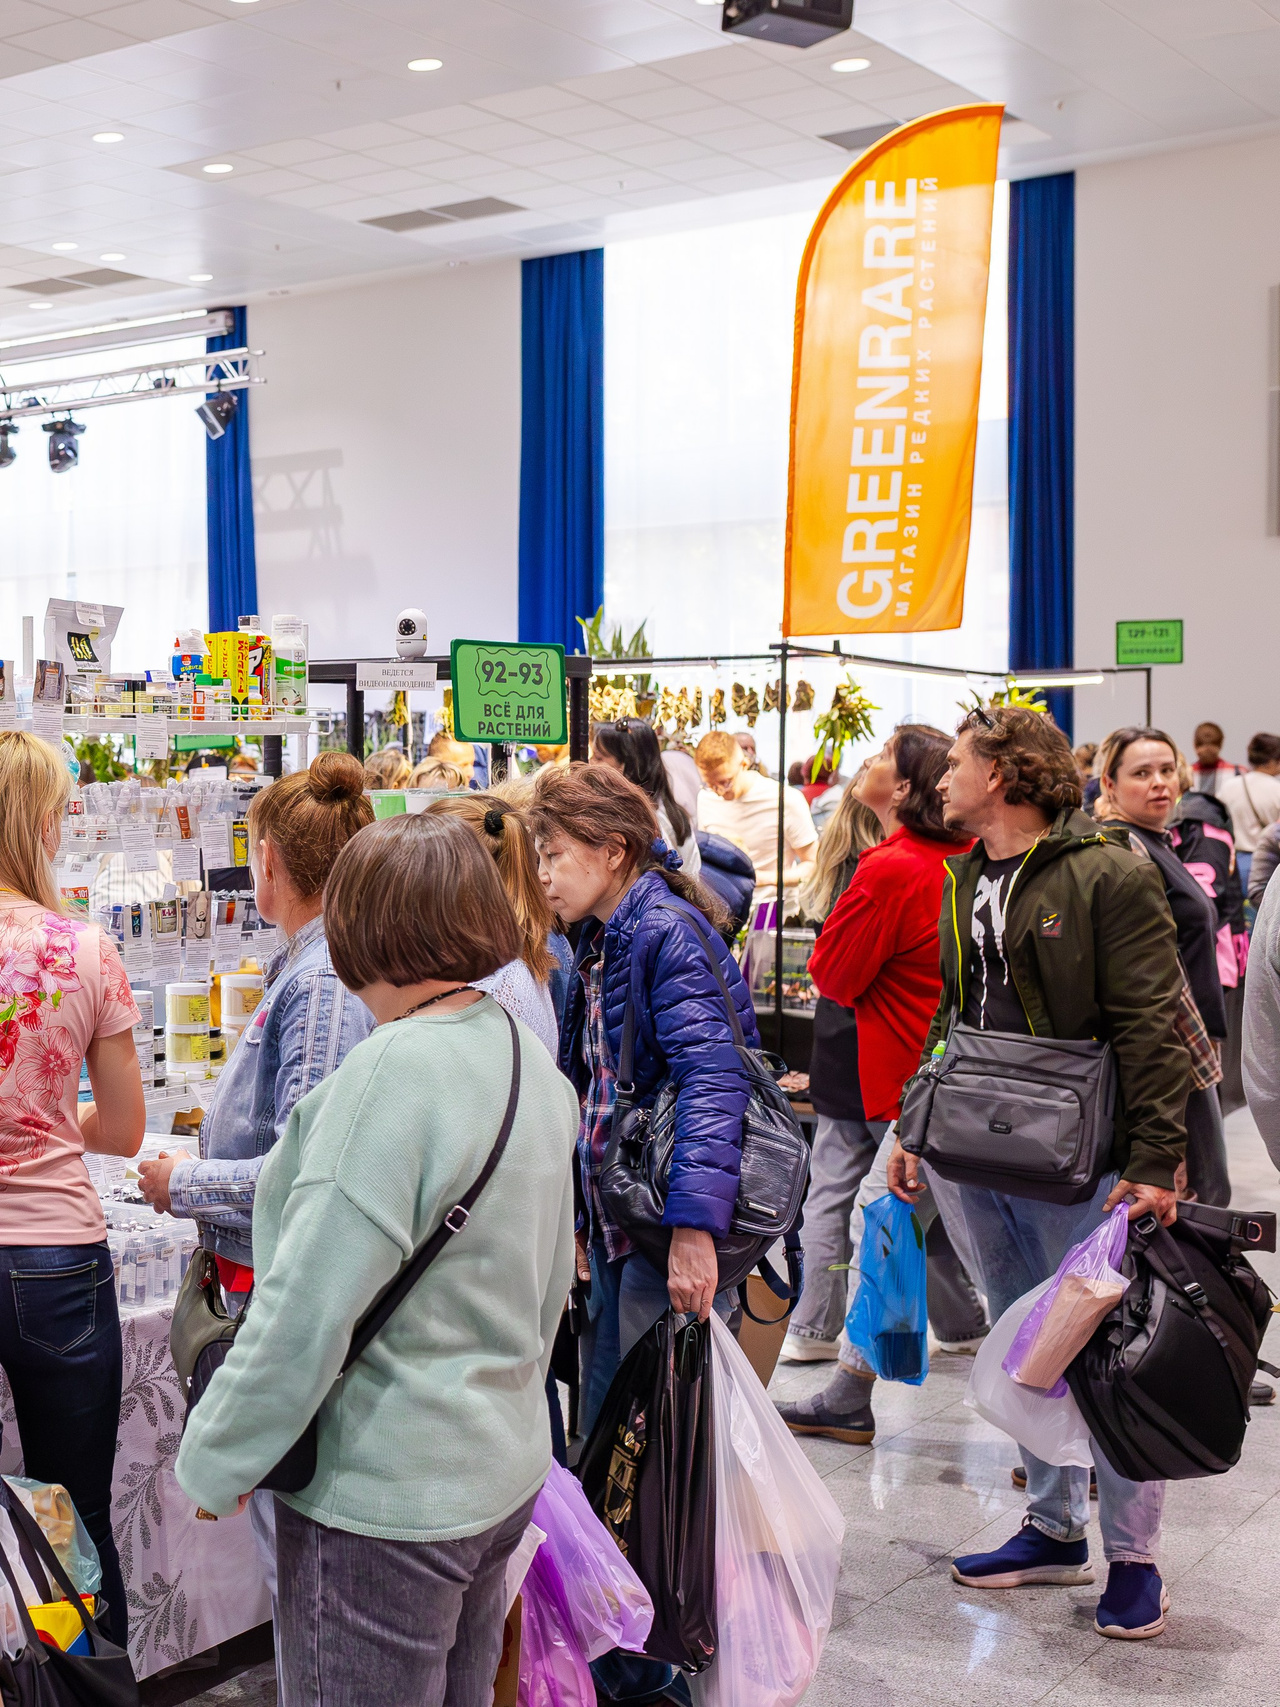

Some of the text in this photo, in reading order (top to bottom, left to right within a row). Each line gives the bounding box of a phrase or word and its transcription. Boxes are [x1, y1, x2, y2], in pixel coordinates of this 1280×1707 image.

[835, 177, 918, 620] GREENRARE
[894, 176, 939, 618] МАГАЗИН РЕДКИХ РАСТЕНИЙ
[381, 668, 415, 677] ВЕДЕТСЯ
[481, 660, 544, 686] 92-93
[358, 679, 435, 689] ВИДЕОНАБЛЮДЕНИЕ!
[483, 701, 545, 720] ВСЁ ДЛЯ
[477, 720, 552, 737] РАСТЕНИЙ
